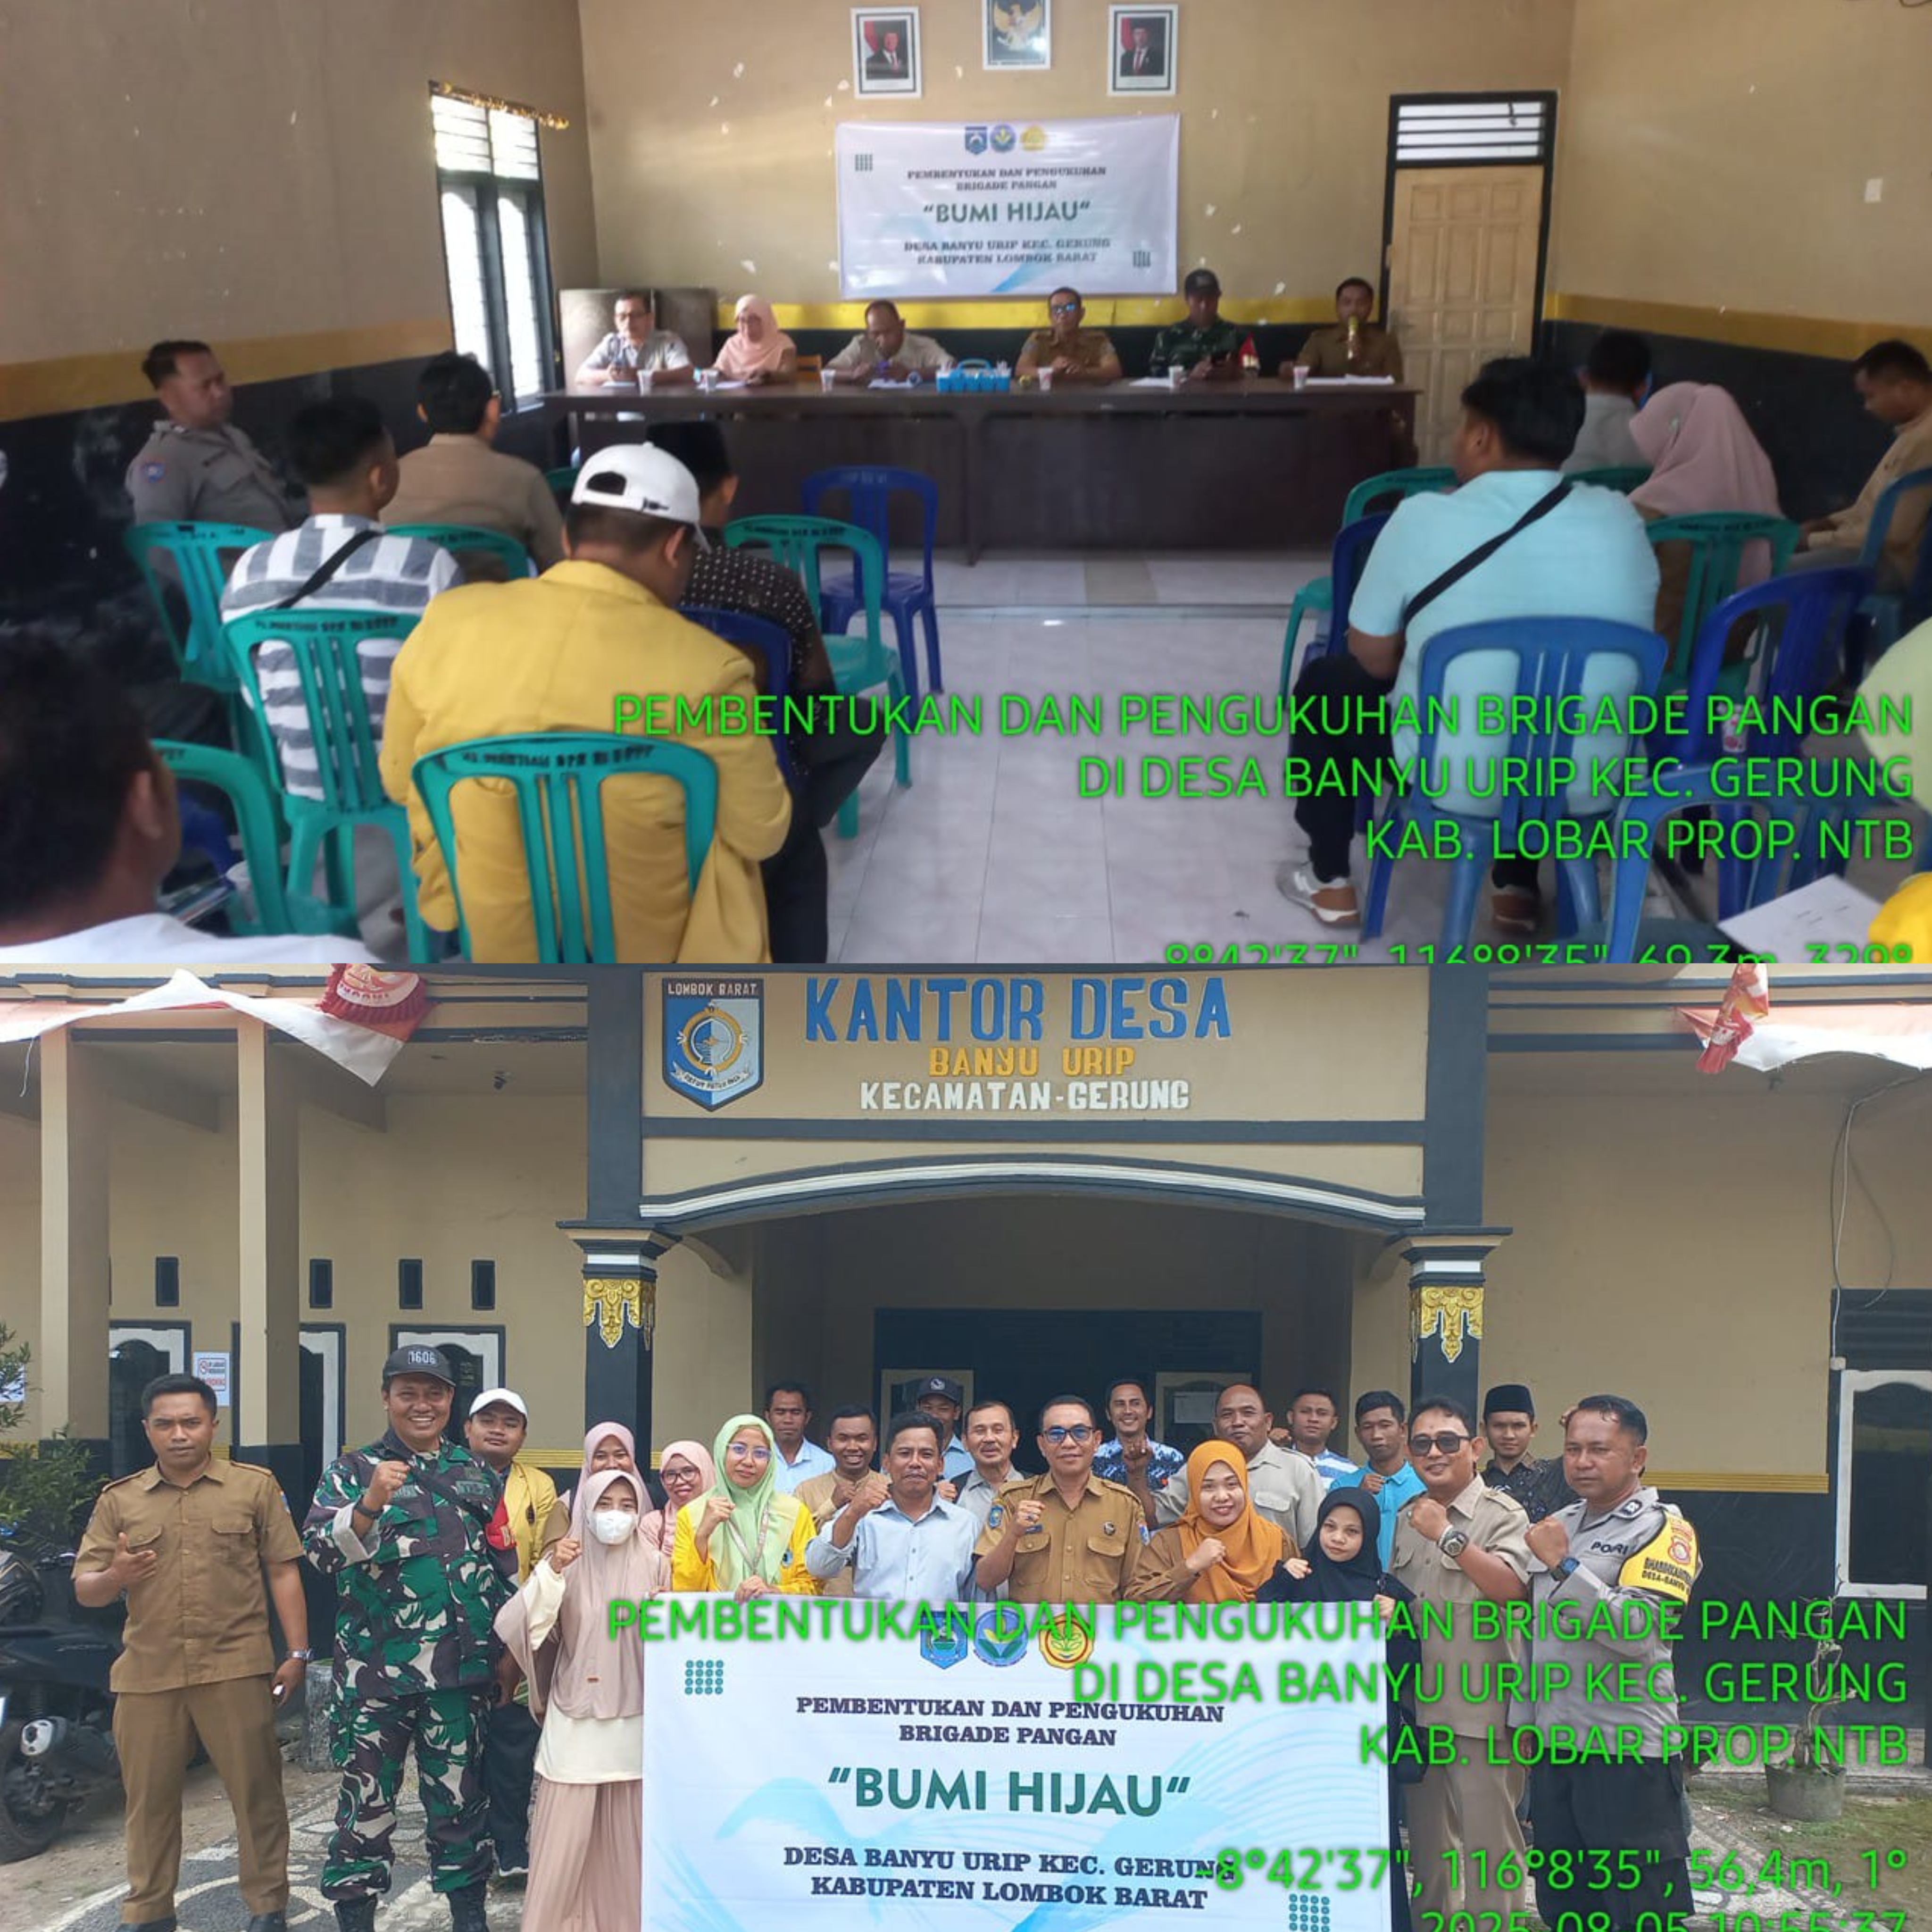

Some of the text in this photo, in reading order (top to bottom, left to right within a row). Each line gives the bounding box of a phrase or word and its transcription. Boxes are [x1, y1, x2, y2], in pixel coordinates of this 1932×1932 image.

[908, 168, 995, 179] PEMBENTUKAN
[999, 168, 1023, 176] DAN
[956, 180, 1057, 191] BRIGADE PANGAN
[904, 241, 938, 251] DESA
[942, 240, 983, 250] BANYU
[987, 240, 1019, 250] URIP
[1056, 238, 1110, 249] GERUNG
[997, 253, 1052, 264] LOMBOK
[1056, 252, 1098, 262] BARAT
[667, 983, 757, 996] LOMBOK BARAT
[807, 977, 1231, 1041] KANTOR DESA
[928, 1047, 1136, 1077] BANYU URIP
[796, 1697, 1224, 1723] PEMBENTUKAN DAN PENGUKUHAN
[899, 1724, 1117, 1746] BRIGADE PANGAN
[783, 1847, 858, 1867] DESA
[864, 1849, 955, 1870] BANYU
[963, 1852, 1031, 1872] URIP
[1038, 1855, 1105, 1875] KEC.
[811, 1876, 1208, 1909] KABUPATEN LOMBOK BARAT
